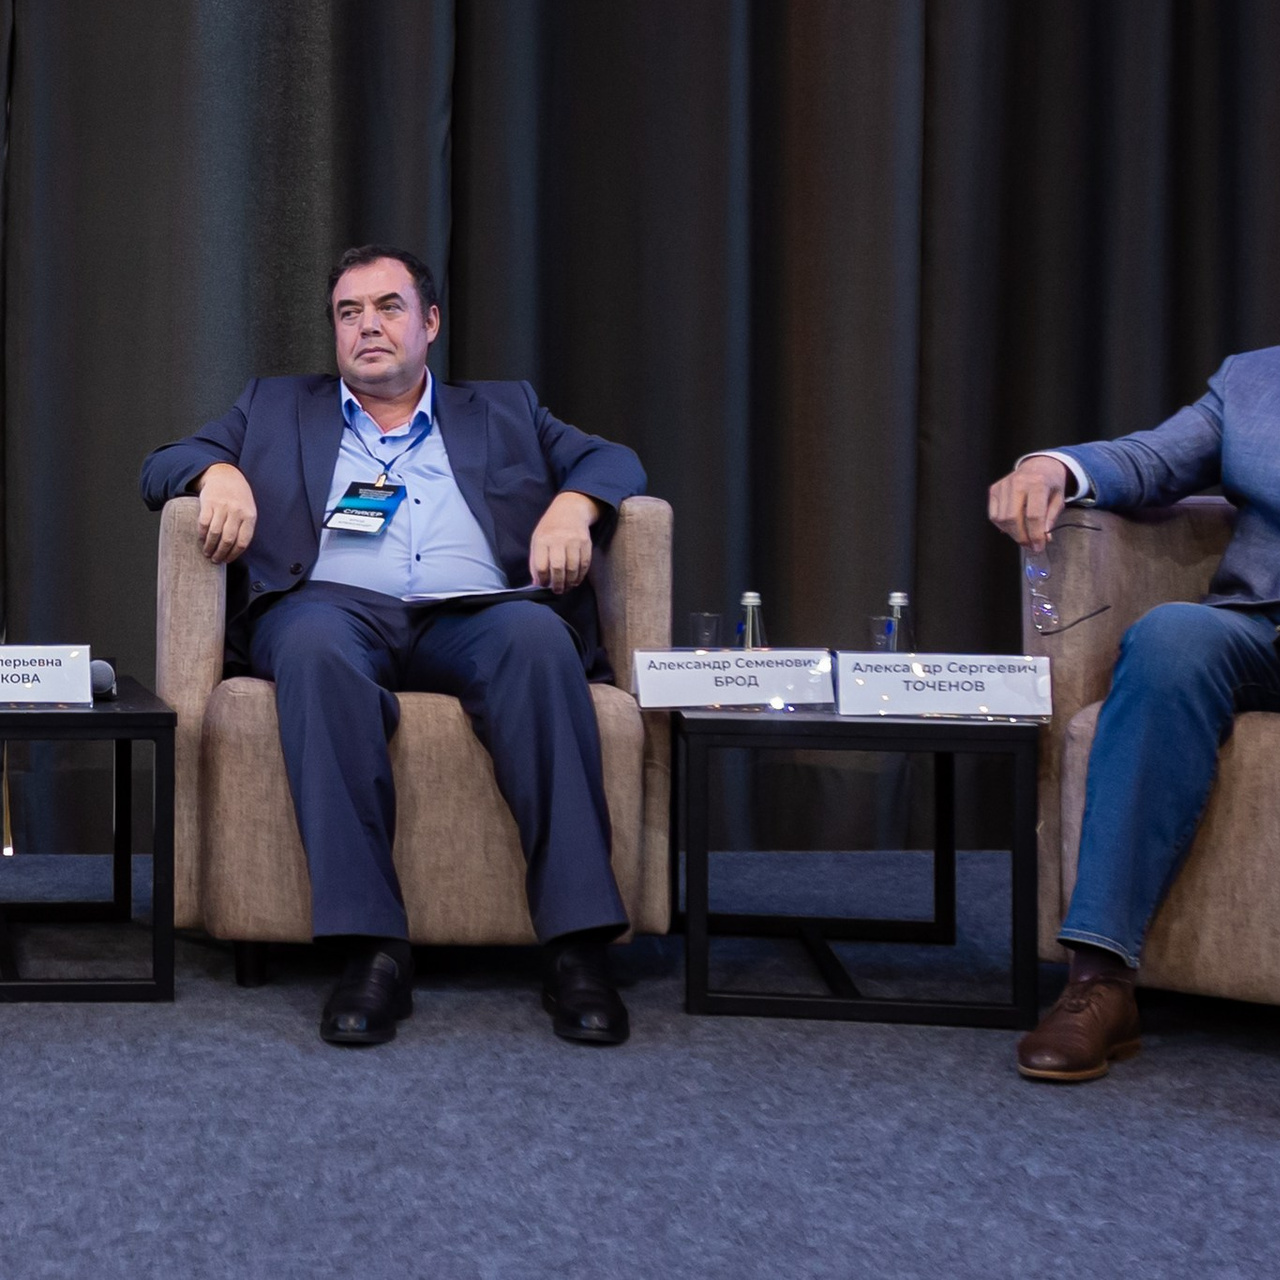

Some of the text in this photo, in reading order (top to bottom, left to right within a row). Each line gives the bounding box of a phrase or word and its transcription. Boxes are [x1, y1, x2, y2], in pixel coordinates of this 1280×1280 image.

[647, 659, 731, 671] Александр
[852, 662, 1038, 676] Алексадр Сергеевич
[714, 675, 760, 688] БРОД
[903, 680, 986, 692] ТОЧЕНОВ
